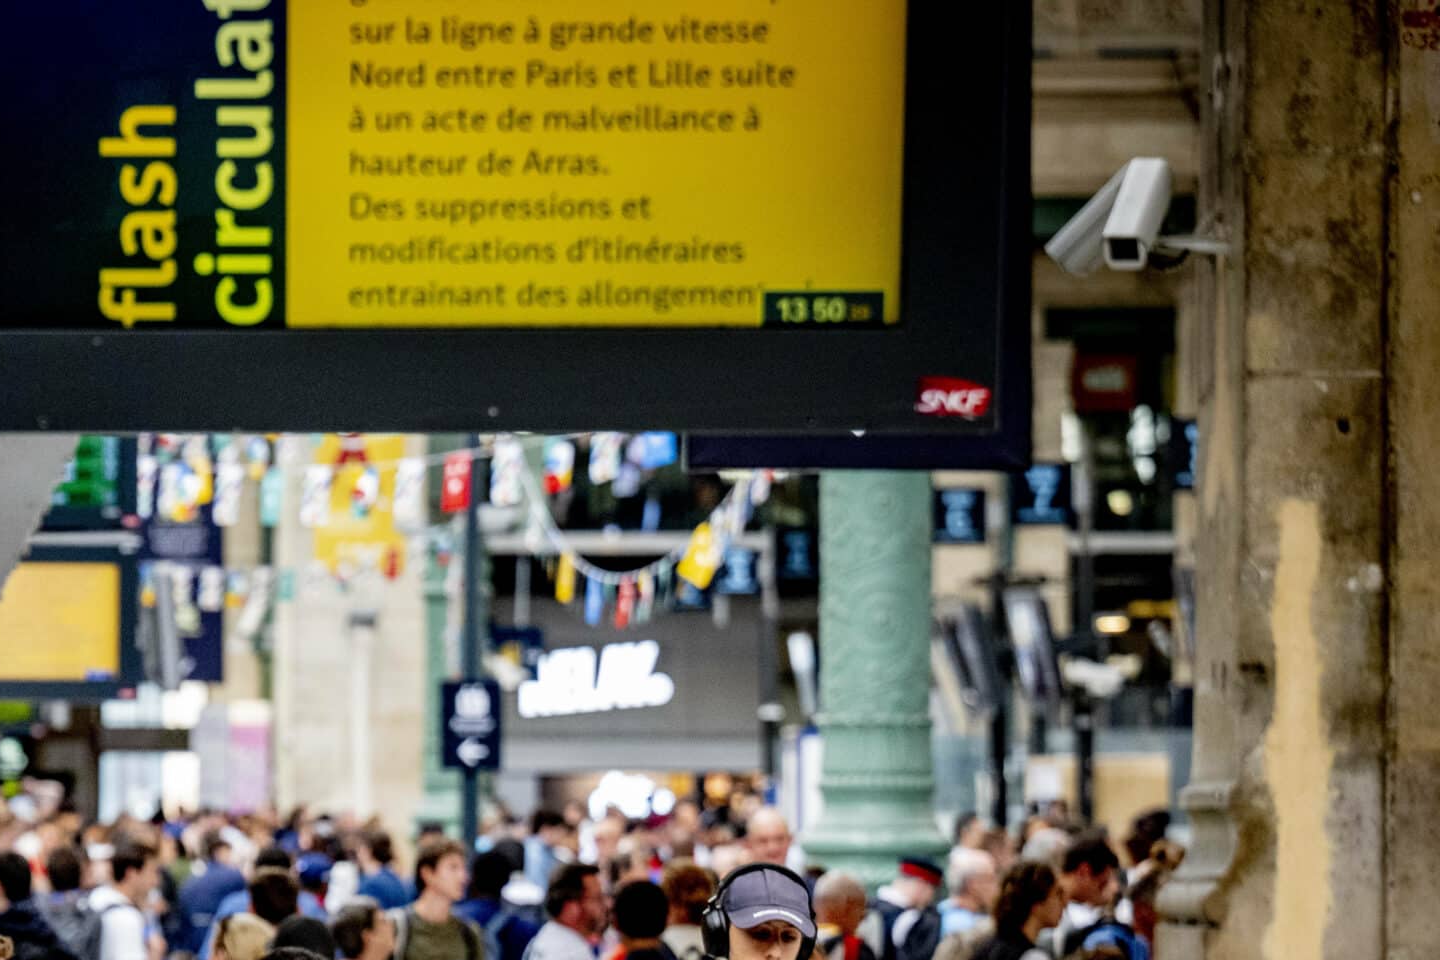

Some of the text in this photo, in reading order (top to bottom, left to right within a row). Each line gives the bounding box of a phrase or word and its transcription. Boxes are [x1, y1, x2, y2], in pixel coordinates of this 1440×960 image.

[349, 16, 769, 51] sur la ligne à grande vitesse
[349, 60, 796, 88] Nord entre Paris et Lille suite
[349, 105, 761, 132] à un acte de malveillance à
[349, 151, 610, 176] hauteur de Arras.
[98, 105, 177, 328] flash
[349, 192, 652, 226] Des suppressions et
[348, 235, 746, 263] modifications d'itinéraires
[516, 282, 568, 307] des
[576, 280, 764, 312] allongemen
[776, 297, 807, 322] 13
[813, 297, 846, 322] 50
[916, 388, 988, 413] SNCF
